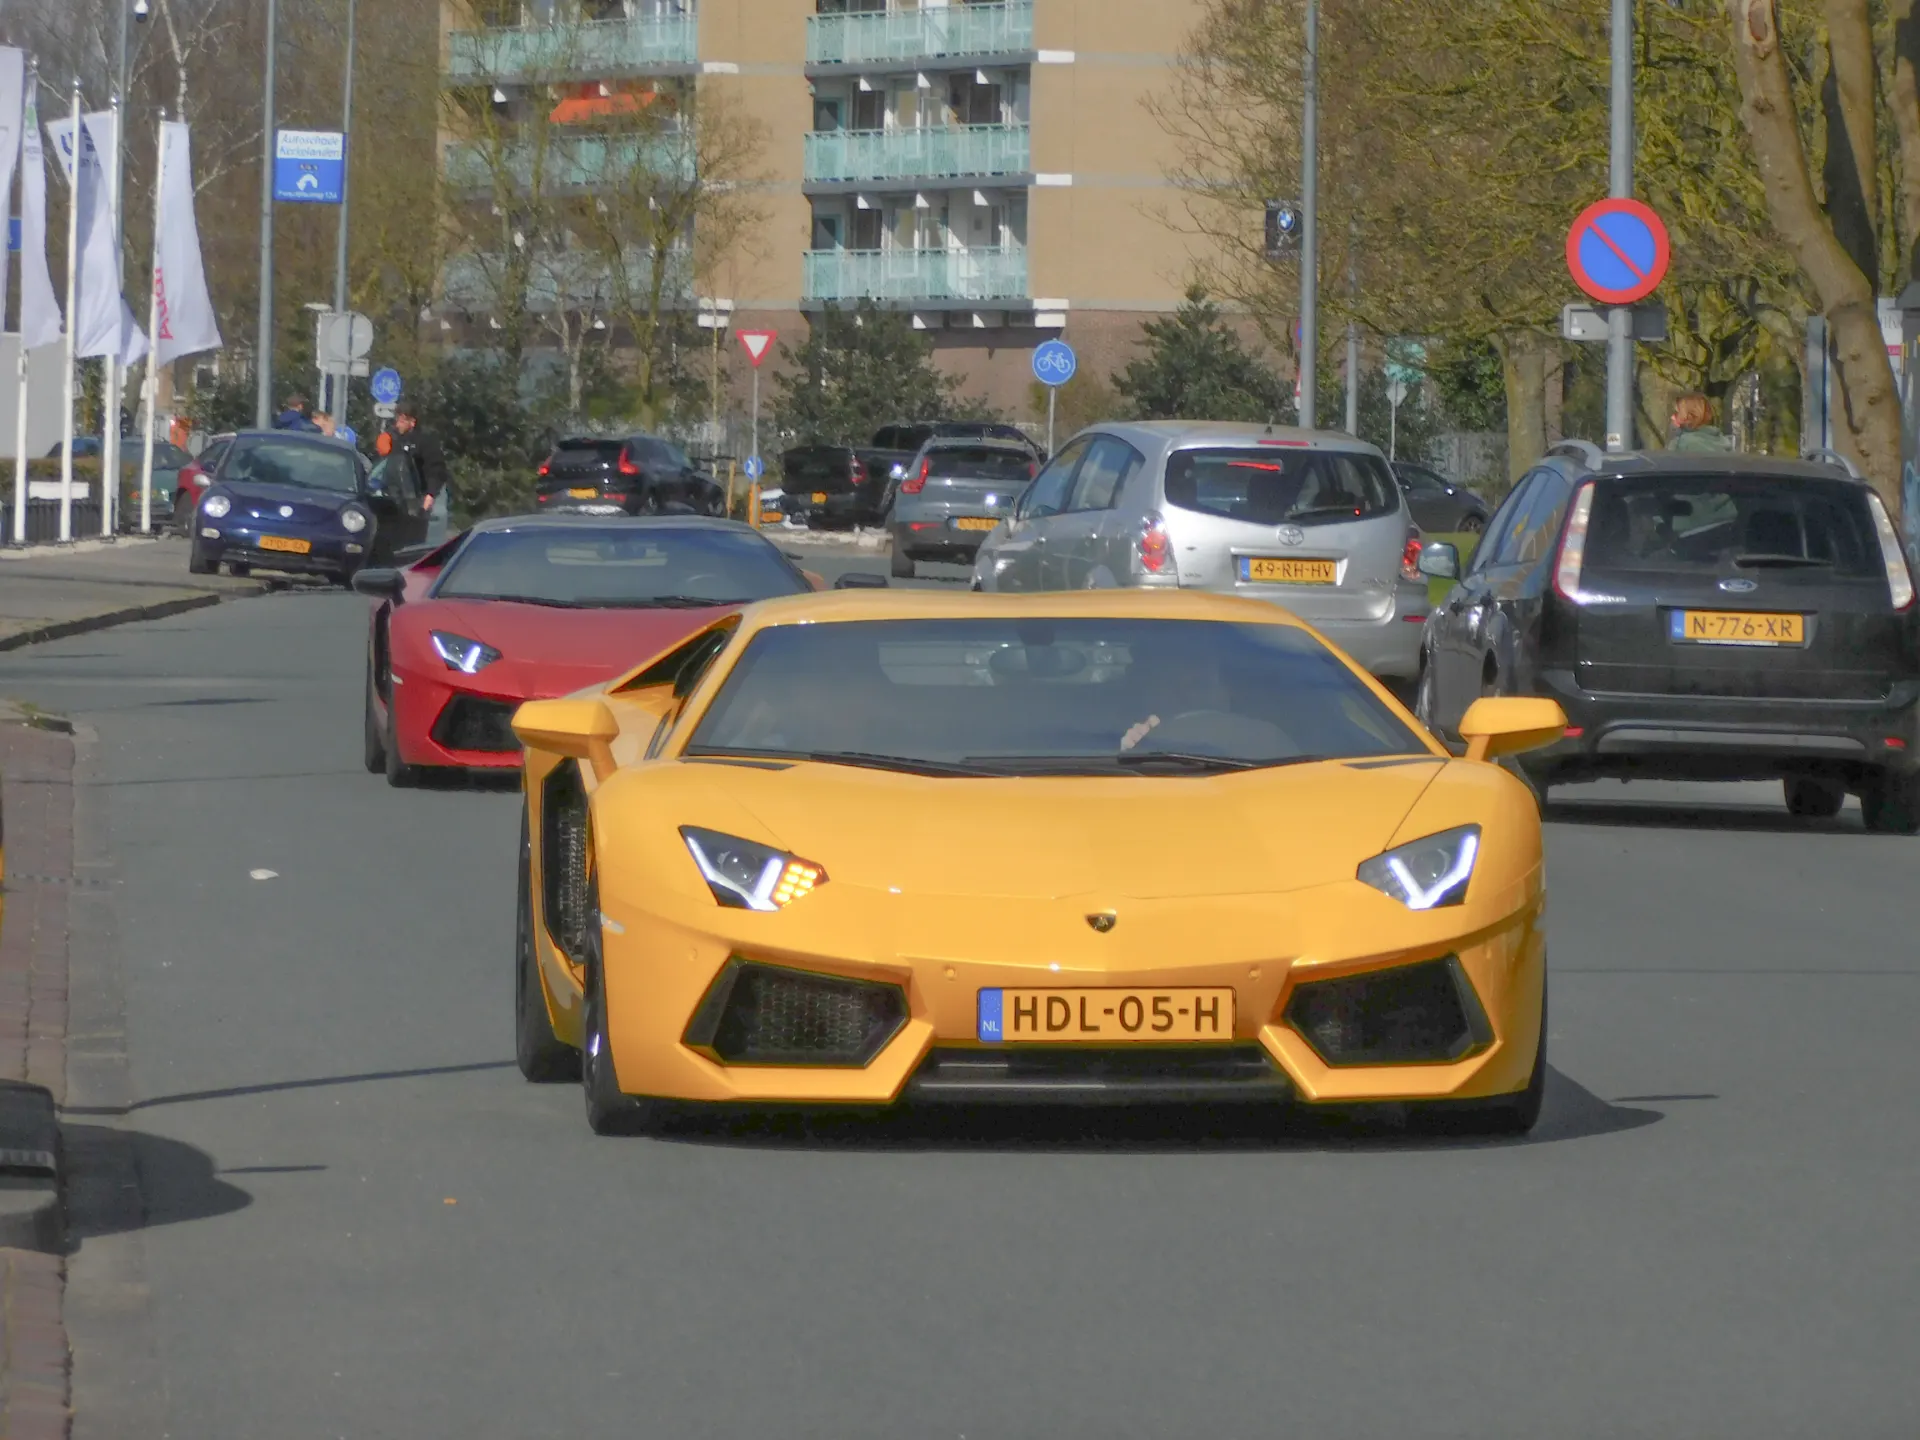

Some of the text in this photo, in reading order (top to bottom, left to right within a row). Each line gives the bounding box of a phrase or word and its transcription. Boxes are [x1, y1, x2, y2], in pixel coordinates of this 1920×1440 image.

[1253, 560, 1334, 579] 49-RH-HV
[1692, 615, 1793, 638] N-776-XR
[982, 996, 1219, 1032] NL HDL-05-H
